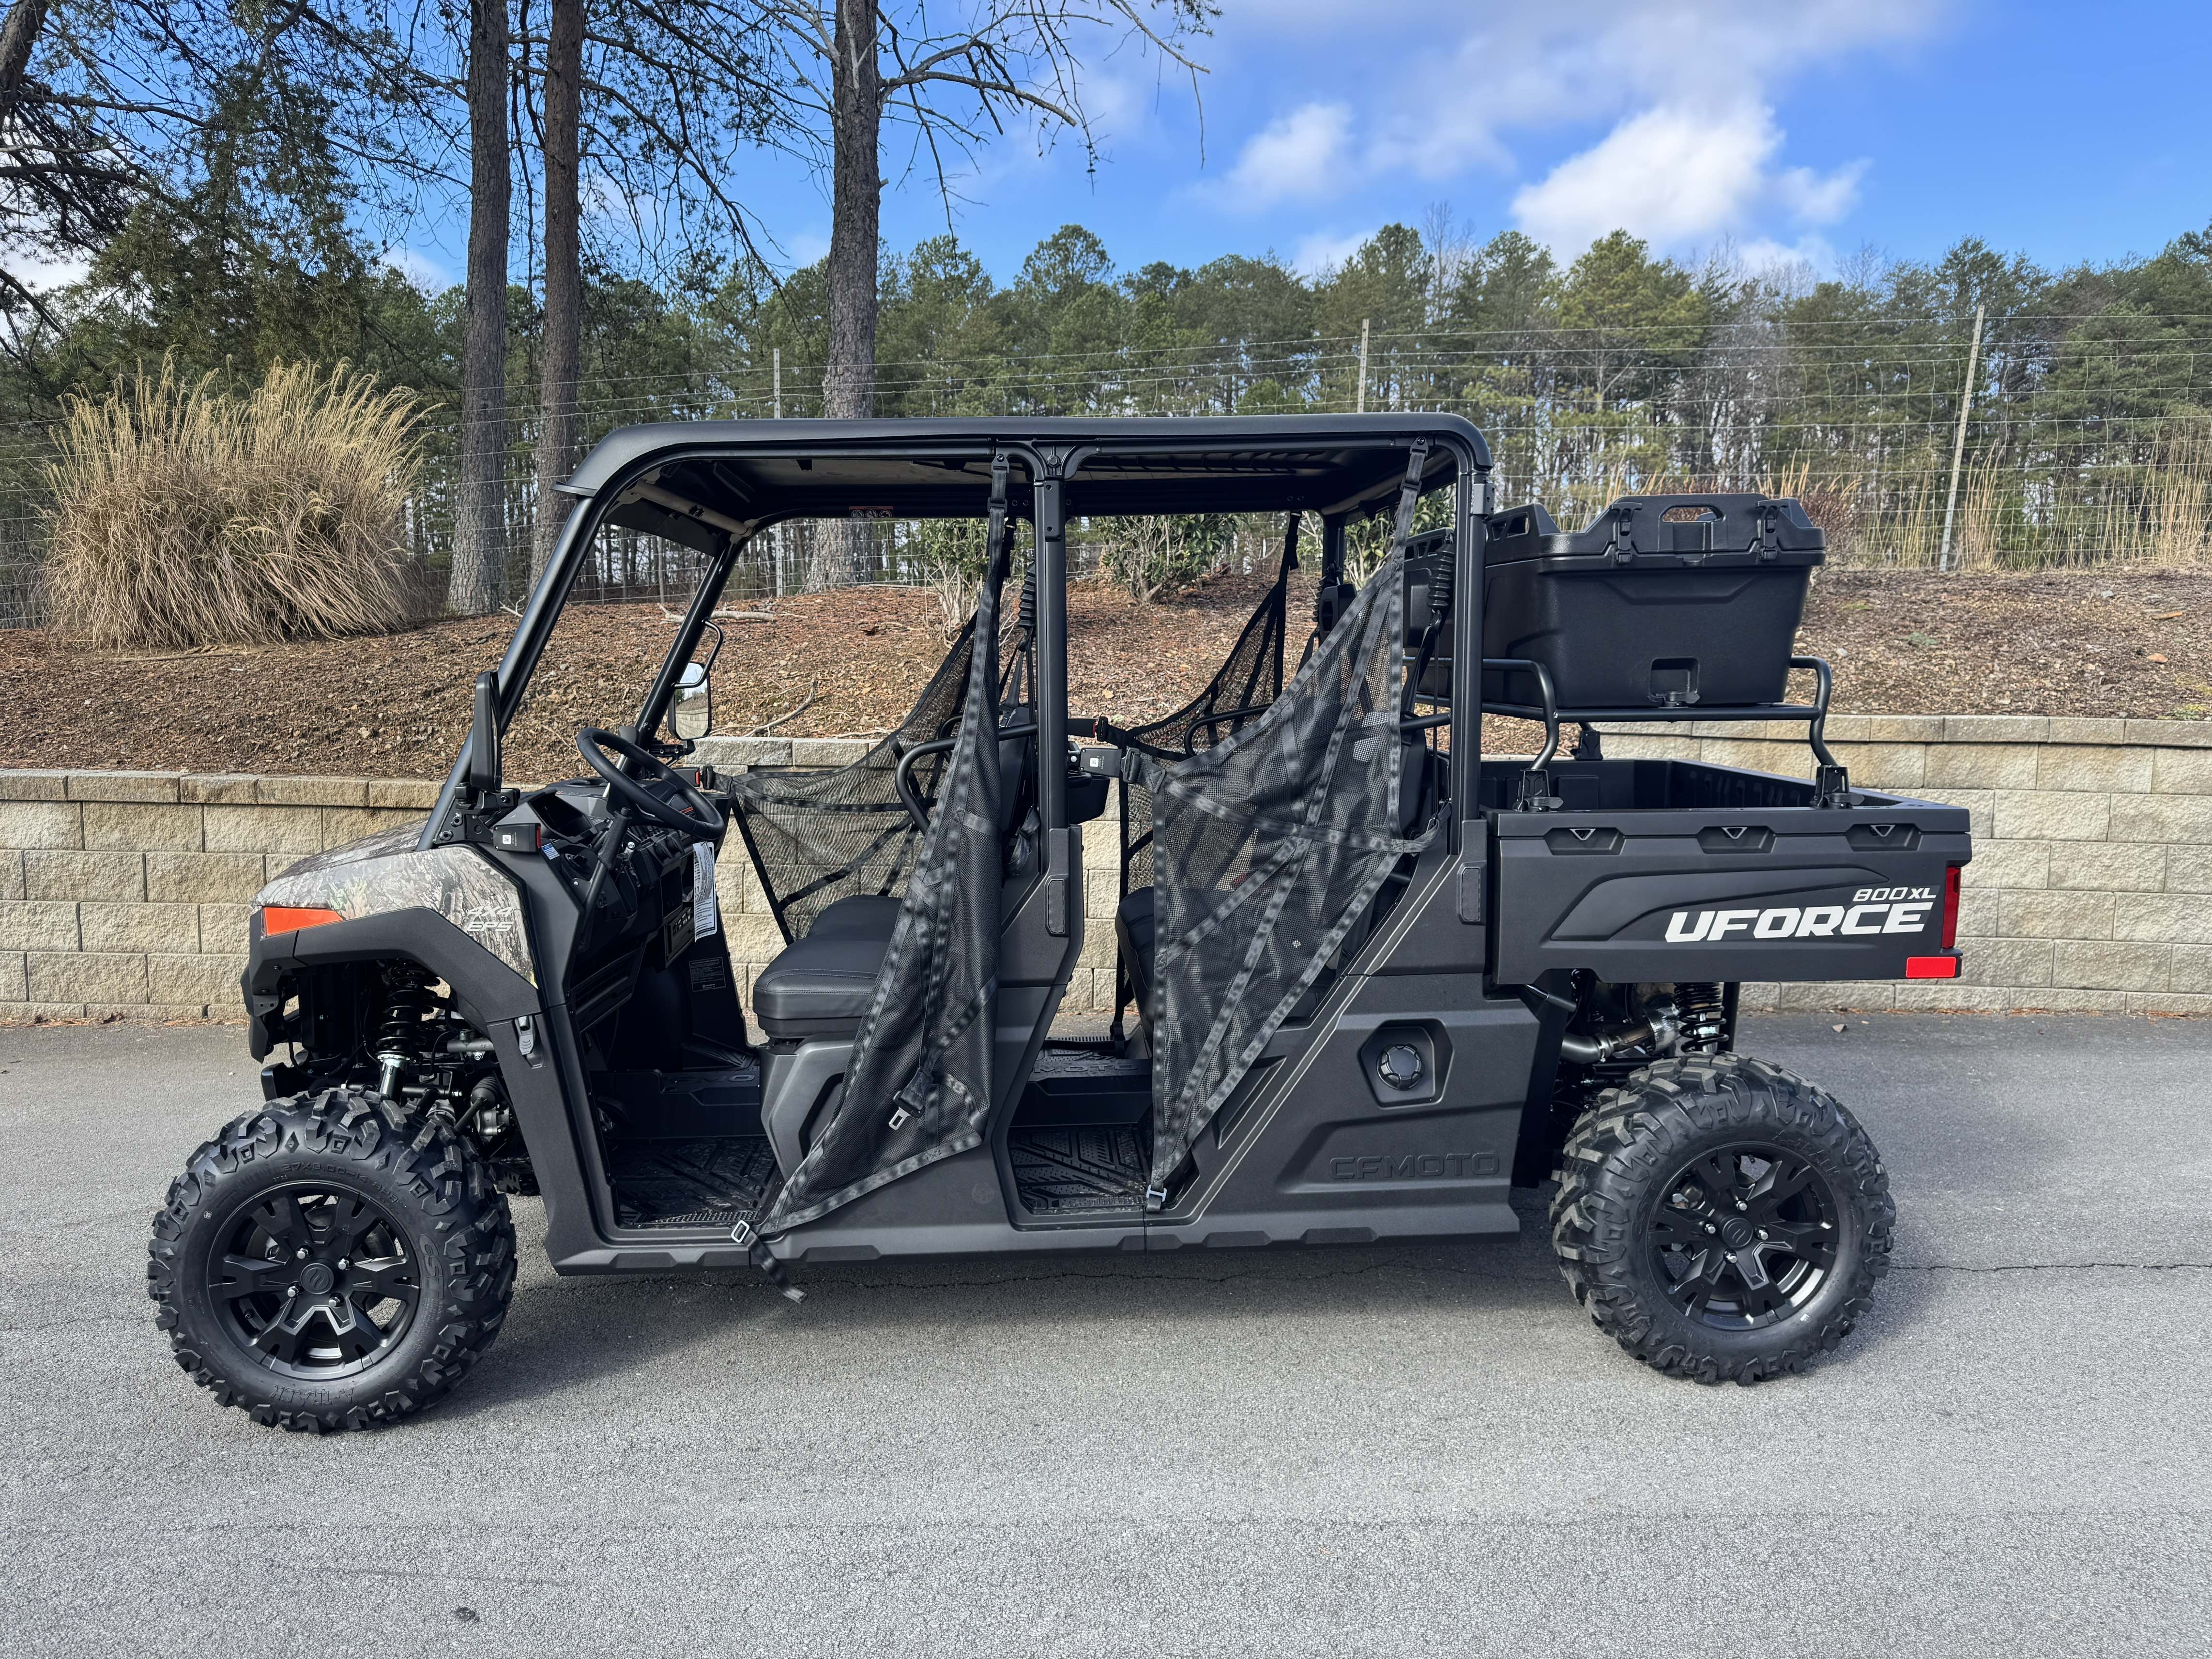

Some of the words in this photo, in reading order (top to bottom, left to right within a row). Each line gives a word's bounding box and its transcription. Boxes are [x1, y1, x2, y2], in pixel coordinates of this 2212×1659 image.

[1853, 887, 1937, 902] 800XL
[467, 905, 513, 918] 4X4
[1664, 901, 1934, 943] UFORCE
[467, 921, 514, 932] EPS
[1329, 1151, 1500, 1180] CFMOTO
[419, 1234, 444, 1299] CST
